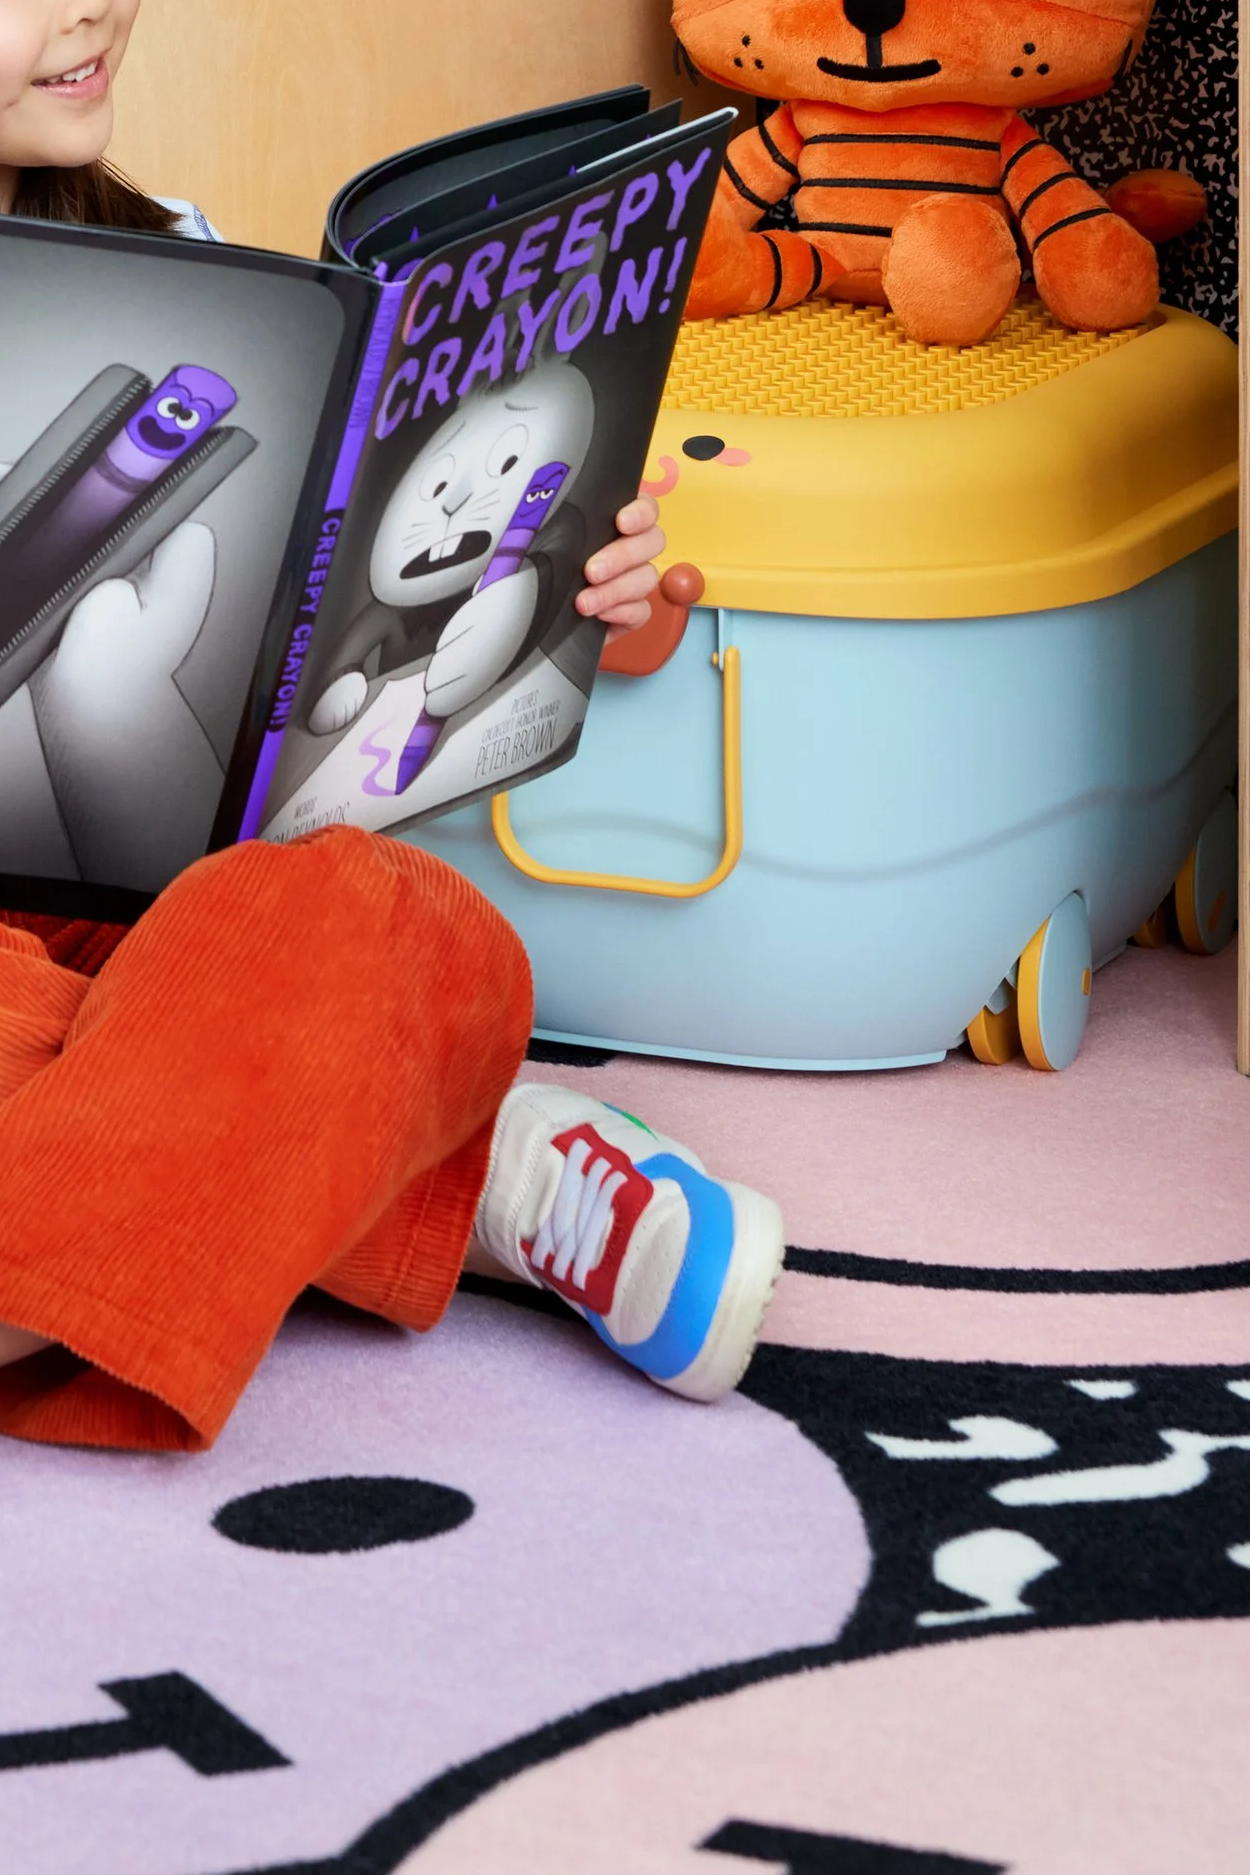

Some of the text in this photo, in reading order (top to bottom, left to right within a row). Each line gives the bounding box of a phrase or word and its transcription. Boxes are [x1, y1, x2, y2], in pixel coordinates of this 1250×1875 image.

[402, 147, 712, 345] CREEPY
[374, 237, 687, 440] CRAYON!
[301, 517, 342, 614] CREEPY
[270, 624, 313, 726] CRAYON!
[474, 717, 557, 780] PETER BROWN
